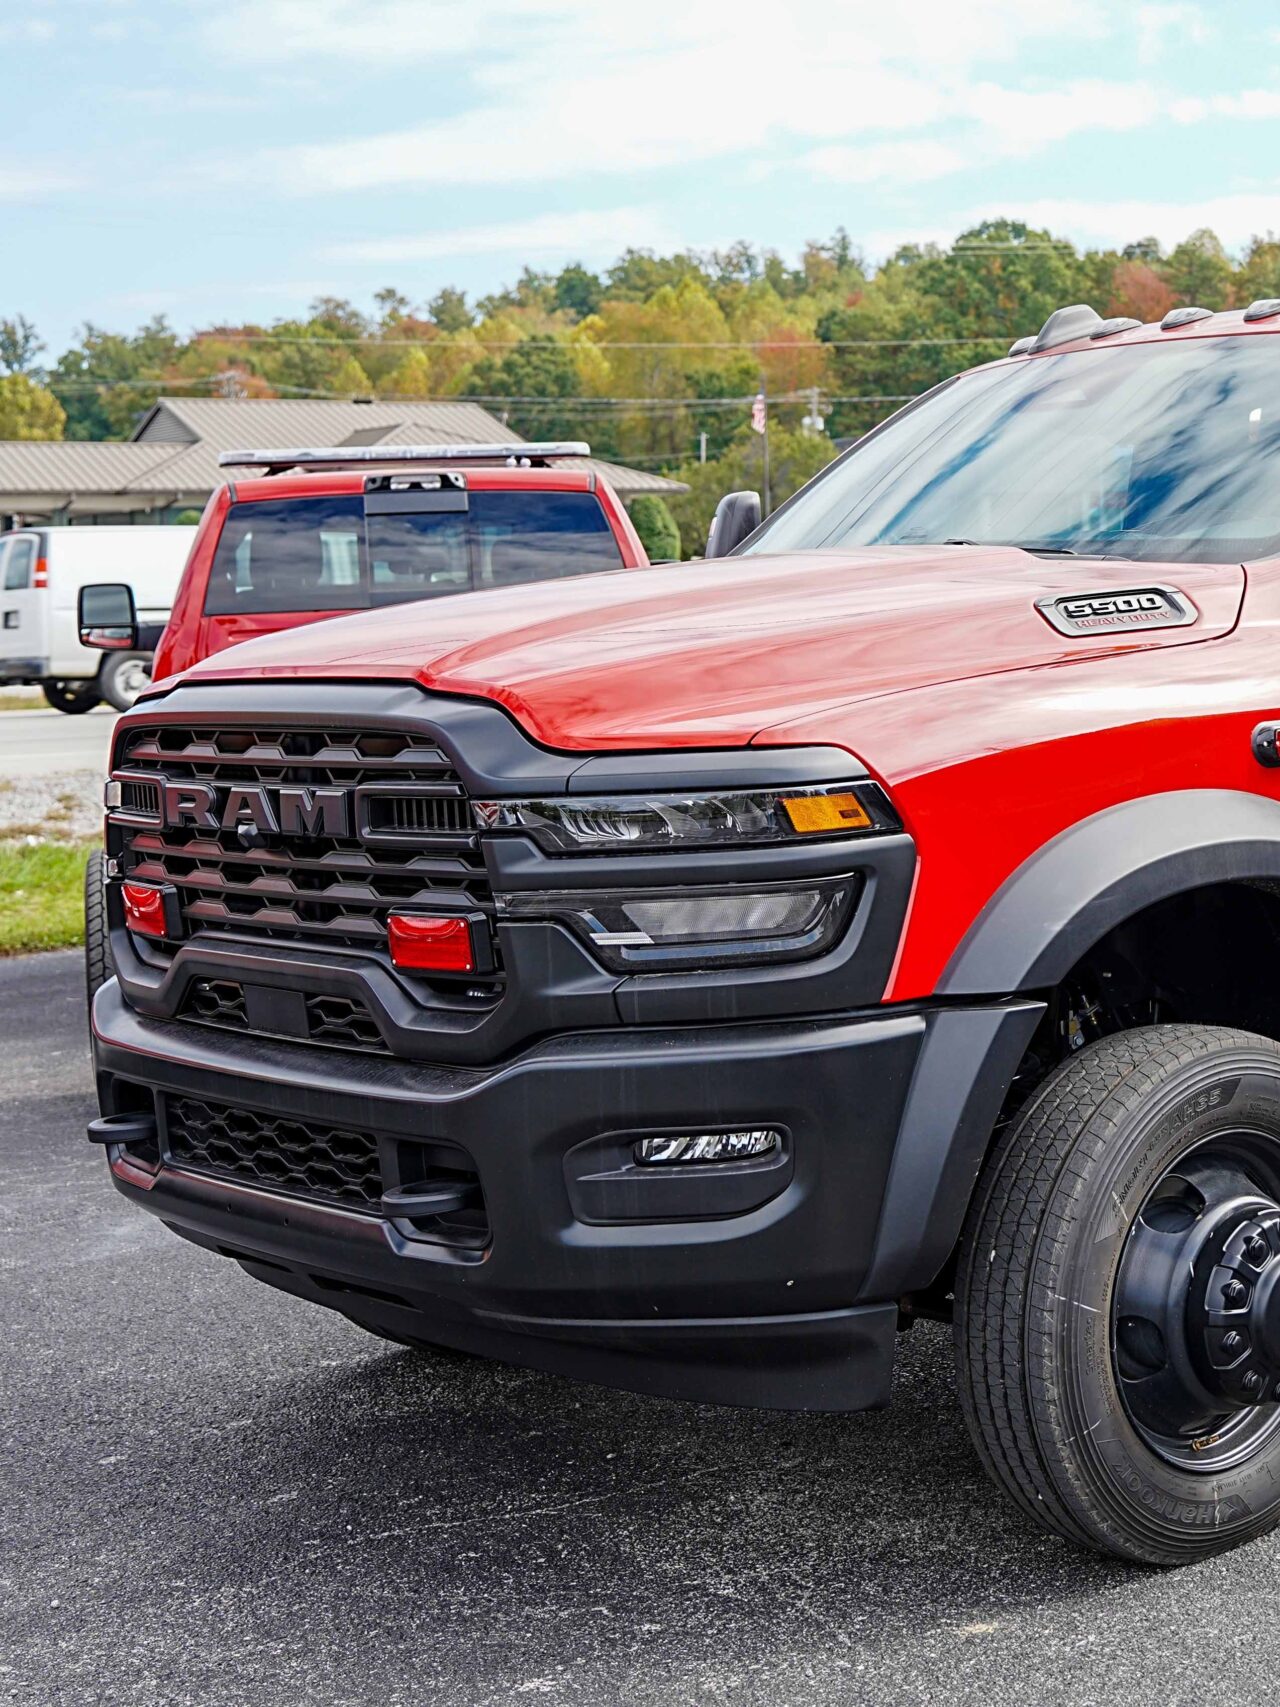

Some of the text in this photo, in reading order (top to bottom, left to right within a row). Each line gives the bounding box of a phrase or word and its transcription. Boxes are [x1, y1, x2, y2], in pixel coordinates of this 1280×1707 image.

[1063, 595, 1164, 619] 5500
[1075, 611, 1172, 628] HEAVY DUTY
[165, 782, 350, 838] RAM
